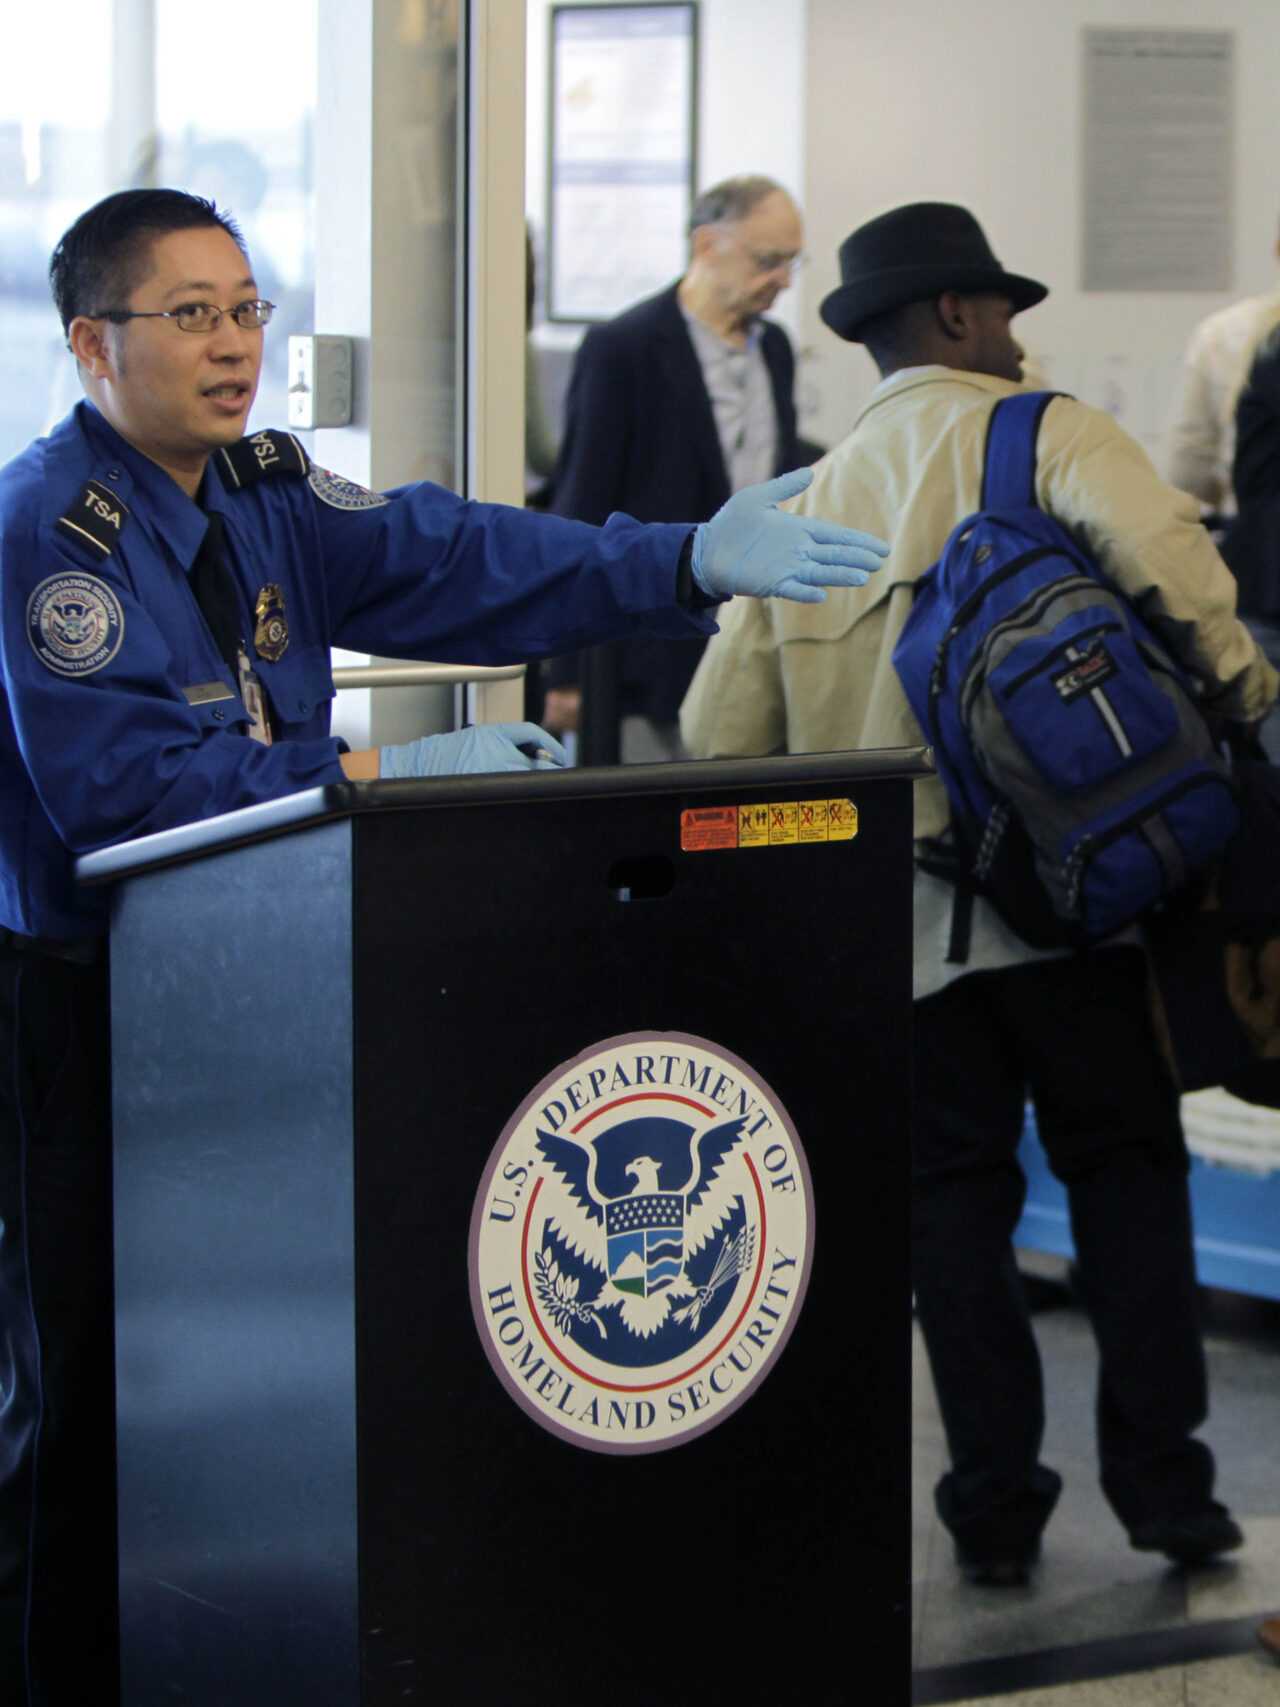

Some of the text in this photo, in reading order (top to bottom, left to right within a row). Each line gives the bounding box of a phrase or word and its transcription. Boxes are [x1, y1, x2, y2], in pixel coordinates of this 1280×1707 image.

[250, 431, 280, 470] TSA
[85, 489, 120, 530] TSA
[31, 578, 92, 626] TRANSPORTATION
[91, 585, 118, 627] SECURITY
[39, 646, 110, 670] ADMINISTRATION
[489, 1055, 797, 1223] U.S. DEPARTMENT OF
[487, 1247, 798, 1431] HOMELAND SECURITY
